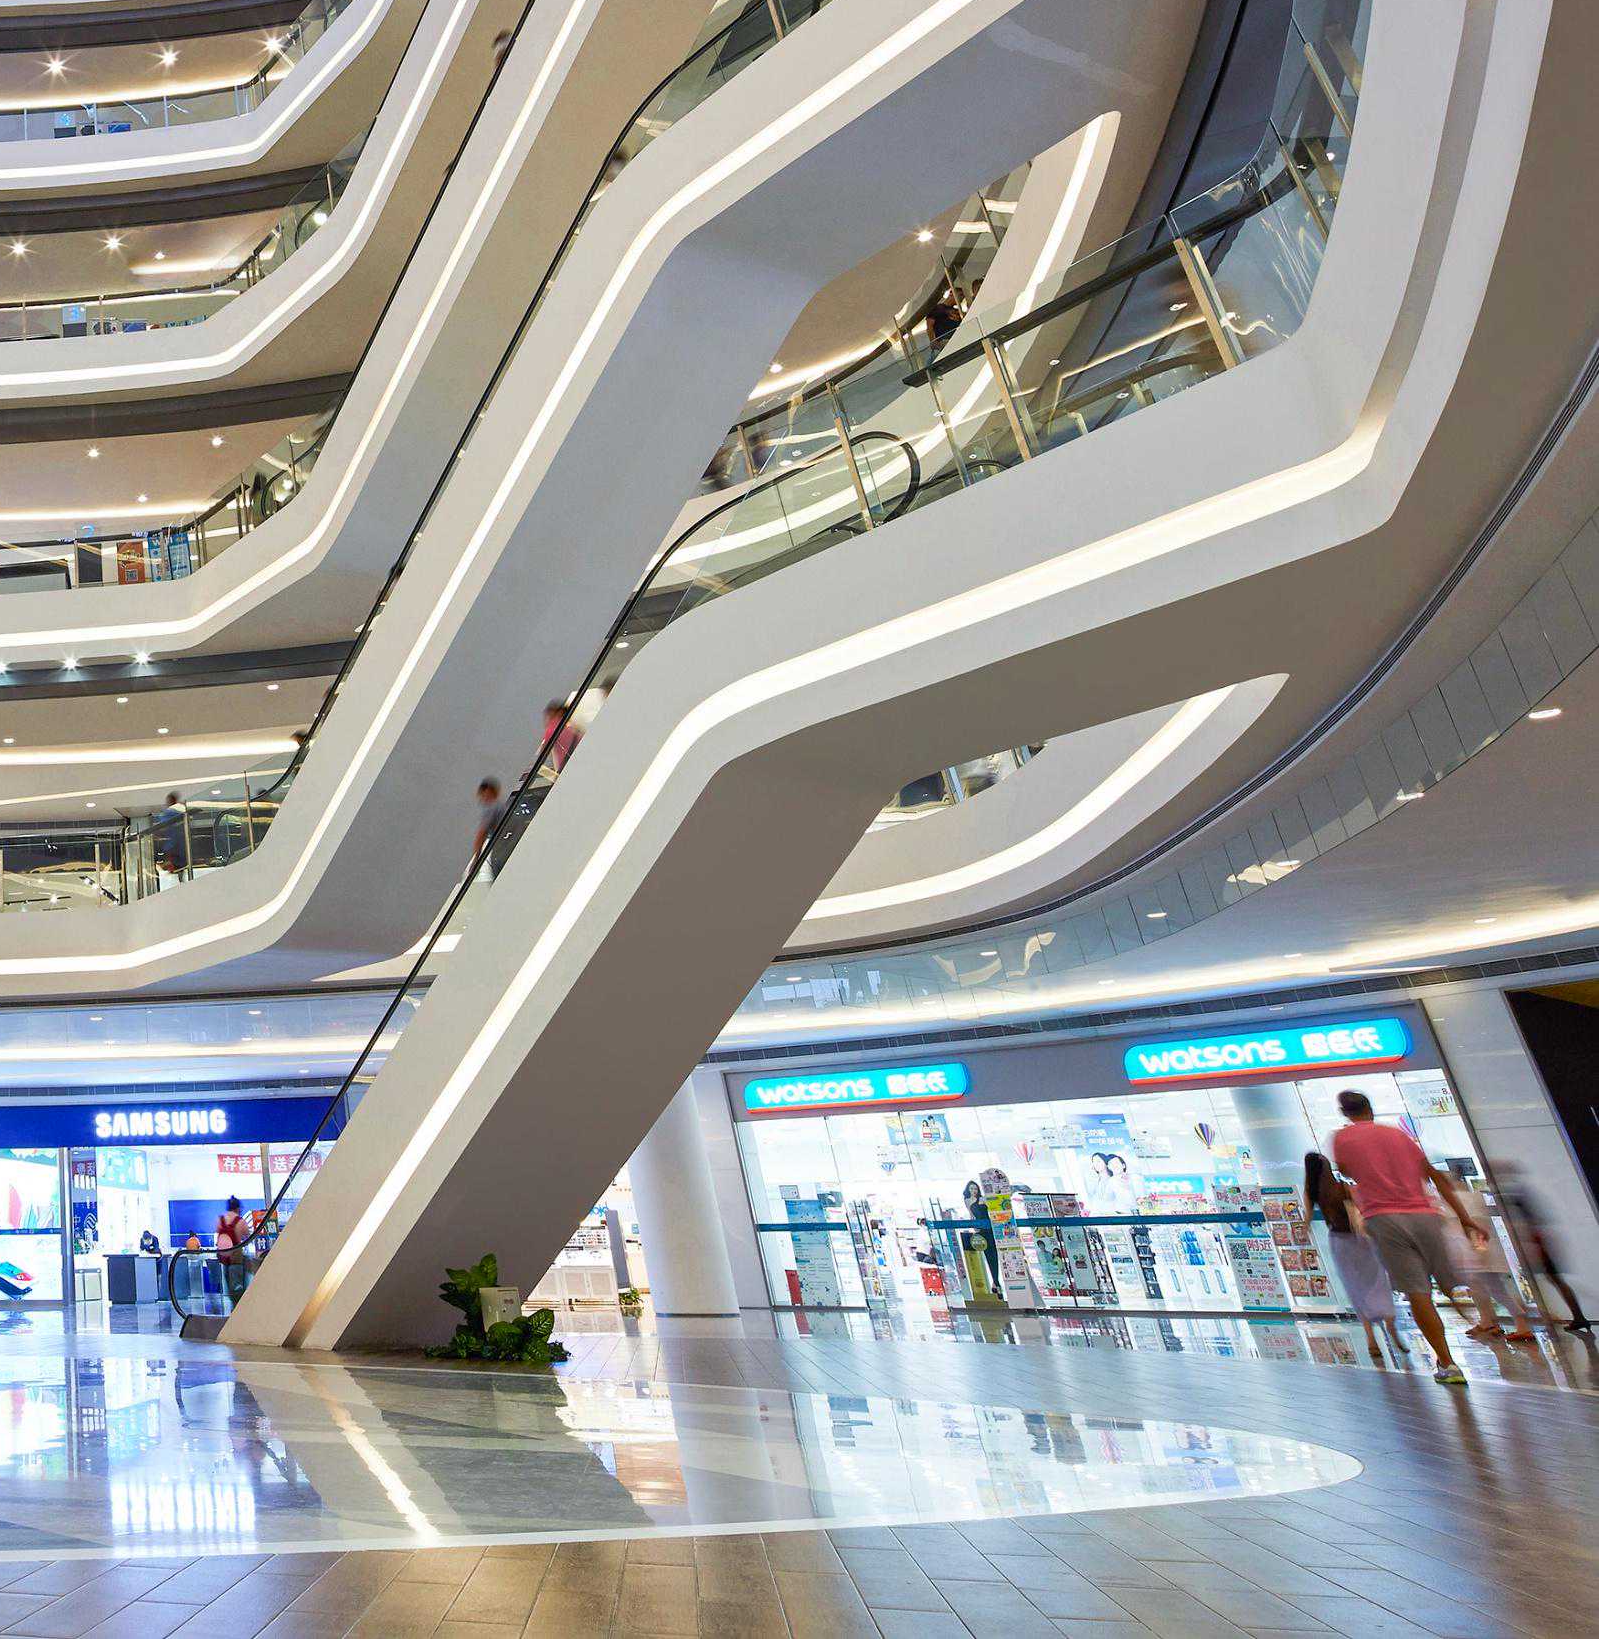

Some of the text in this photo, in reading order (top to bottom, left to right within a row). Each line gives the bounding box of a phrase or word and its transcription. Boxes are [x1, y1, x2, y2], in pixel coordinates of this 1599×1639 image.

[1139, 1039, 1286, 1074] watsons
[756, 1077, 873, 1105] watsons
[94, 1109, 227, 1138] SAMSUNG
